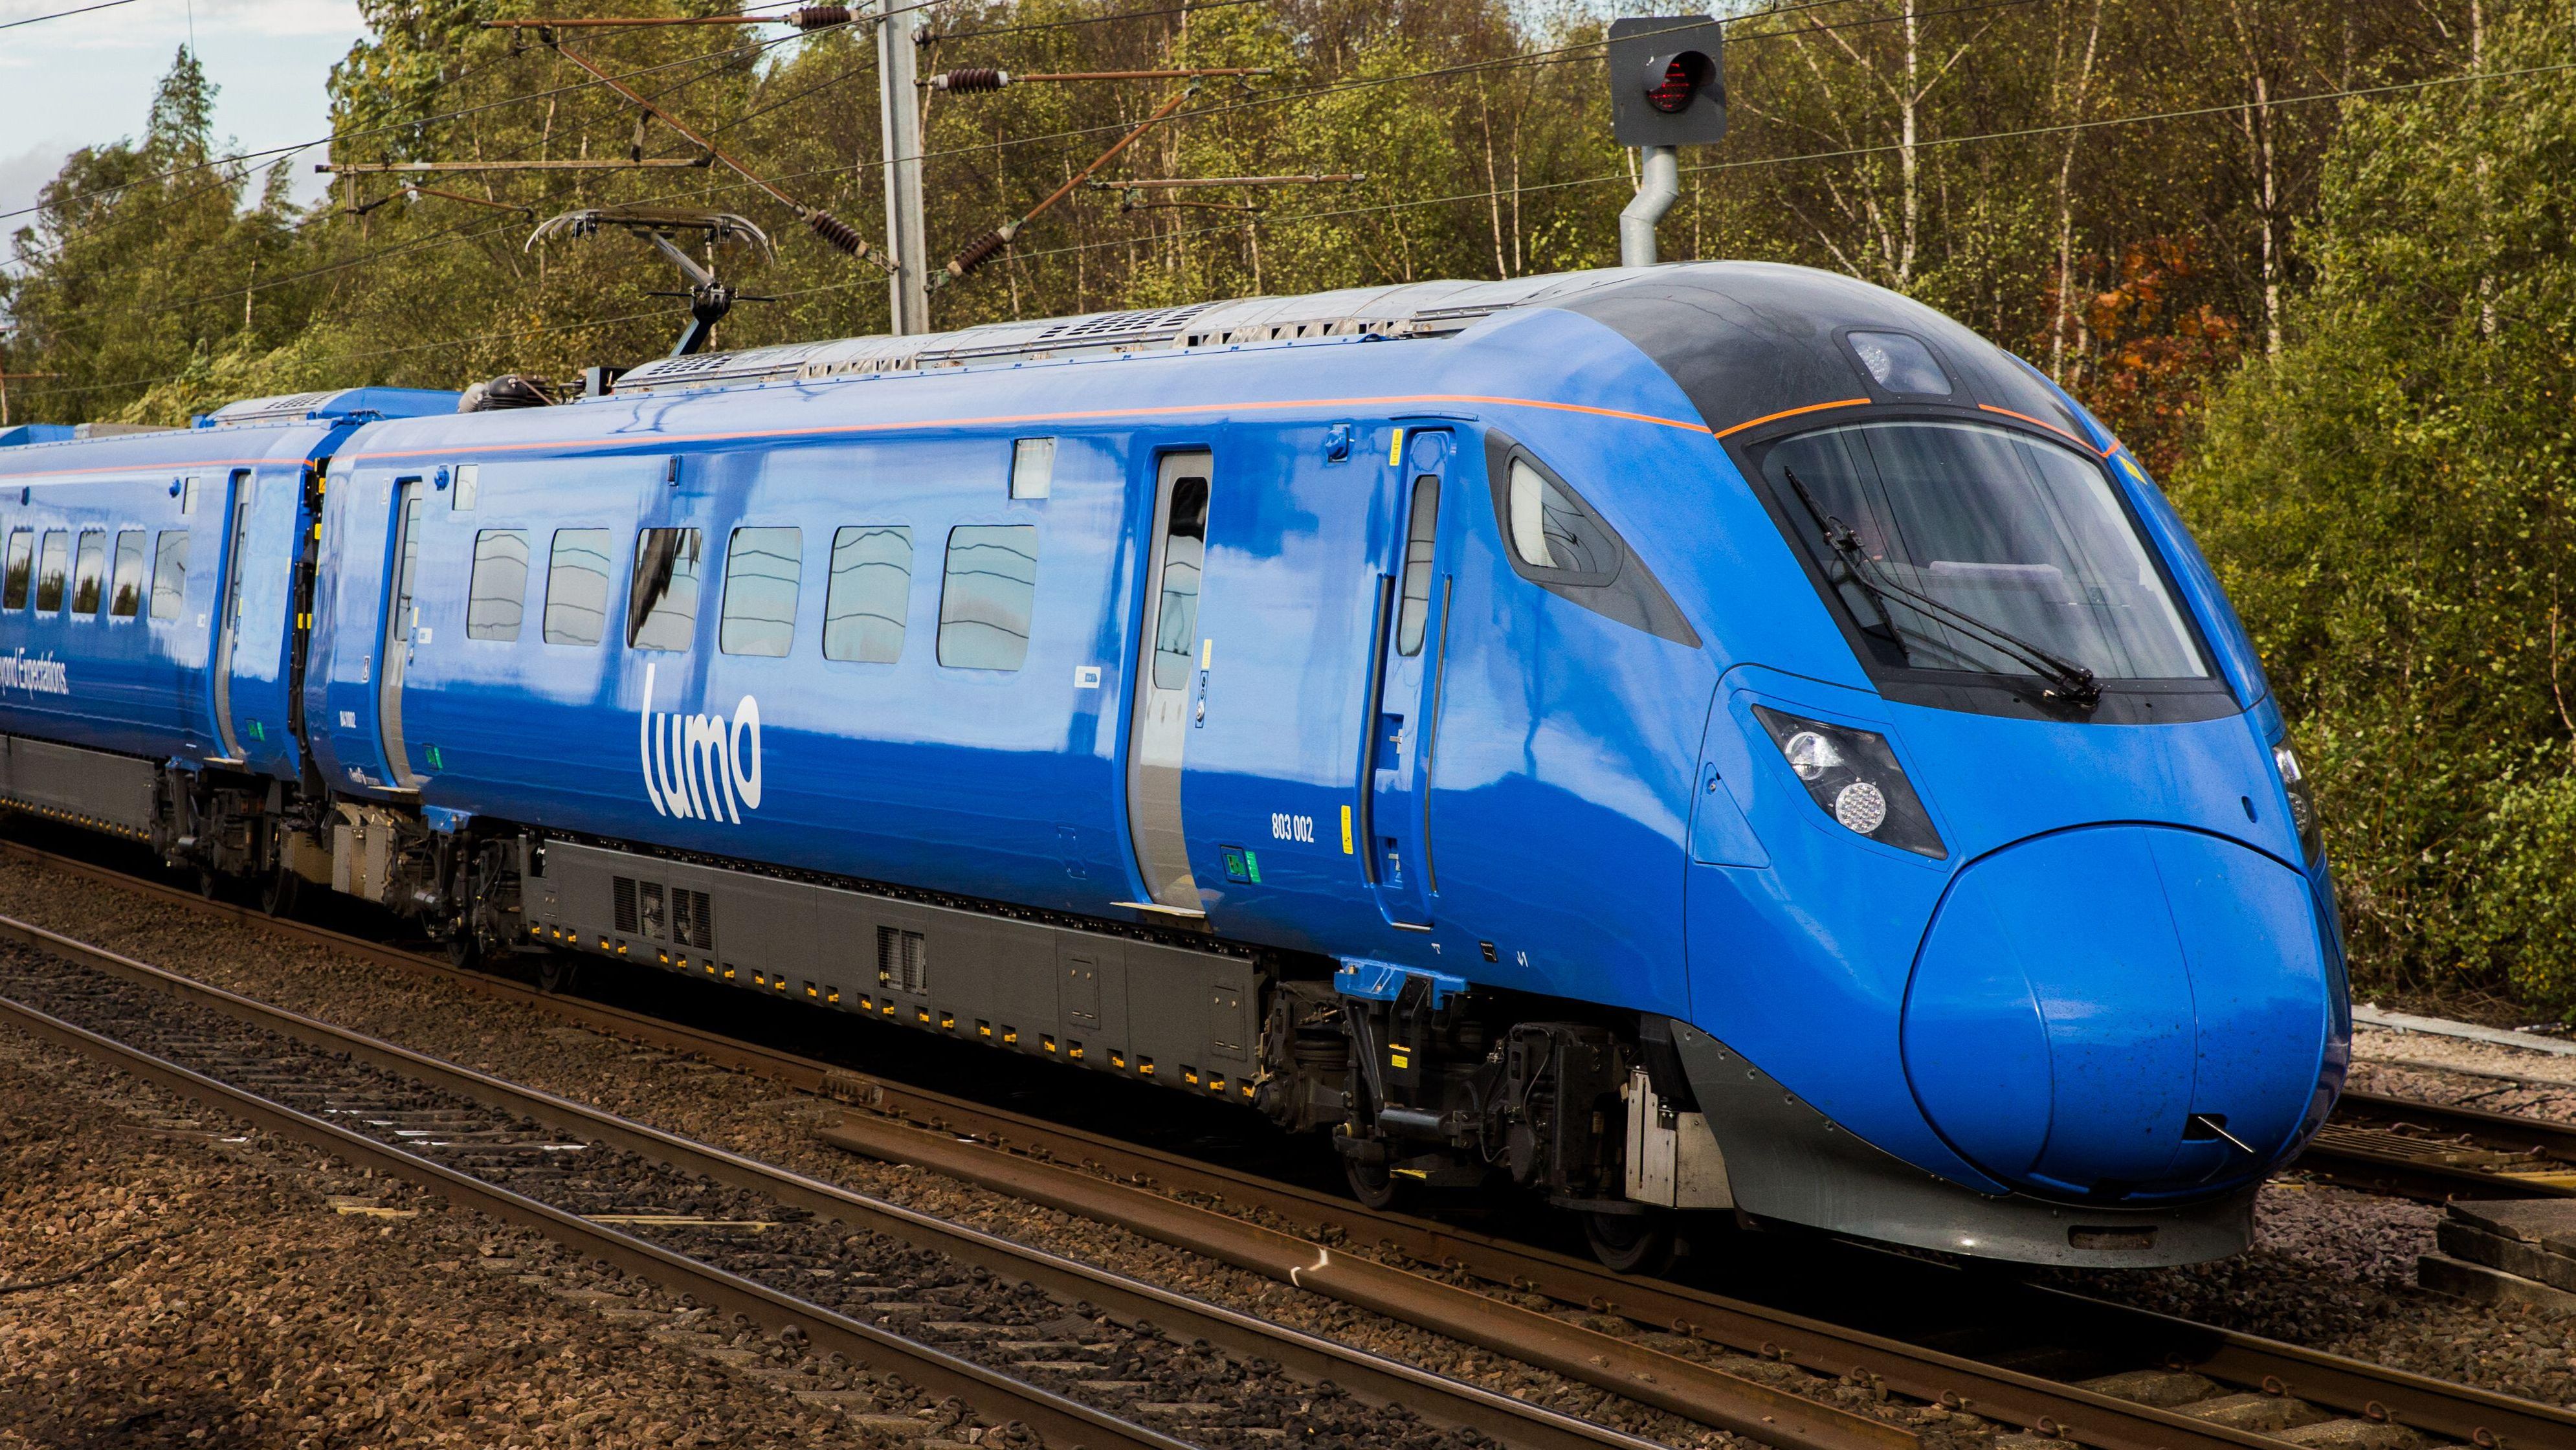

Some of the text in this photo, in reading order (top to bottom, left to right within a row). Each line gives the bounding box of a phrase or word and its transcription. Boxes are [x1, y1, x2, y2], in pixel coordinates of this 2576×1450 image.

[0, 647, 18, 696] yond
[641, 662, 762, 825] lumo
[1272, 812, 1292, 840] 803
[1293, 815, 1314, 843] 002
